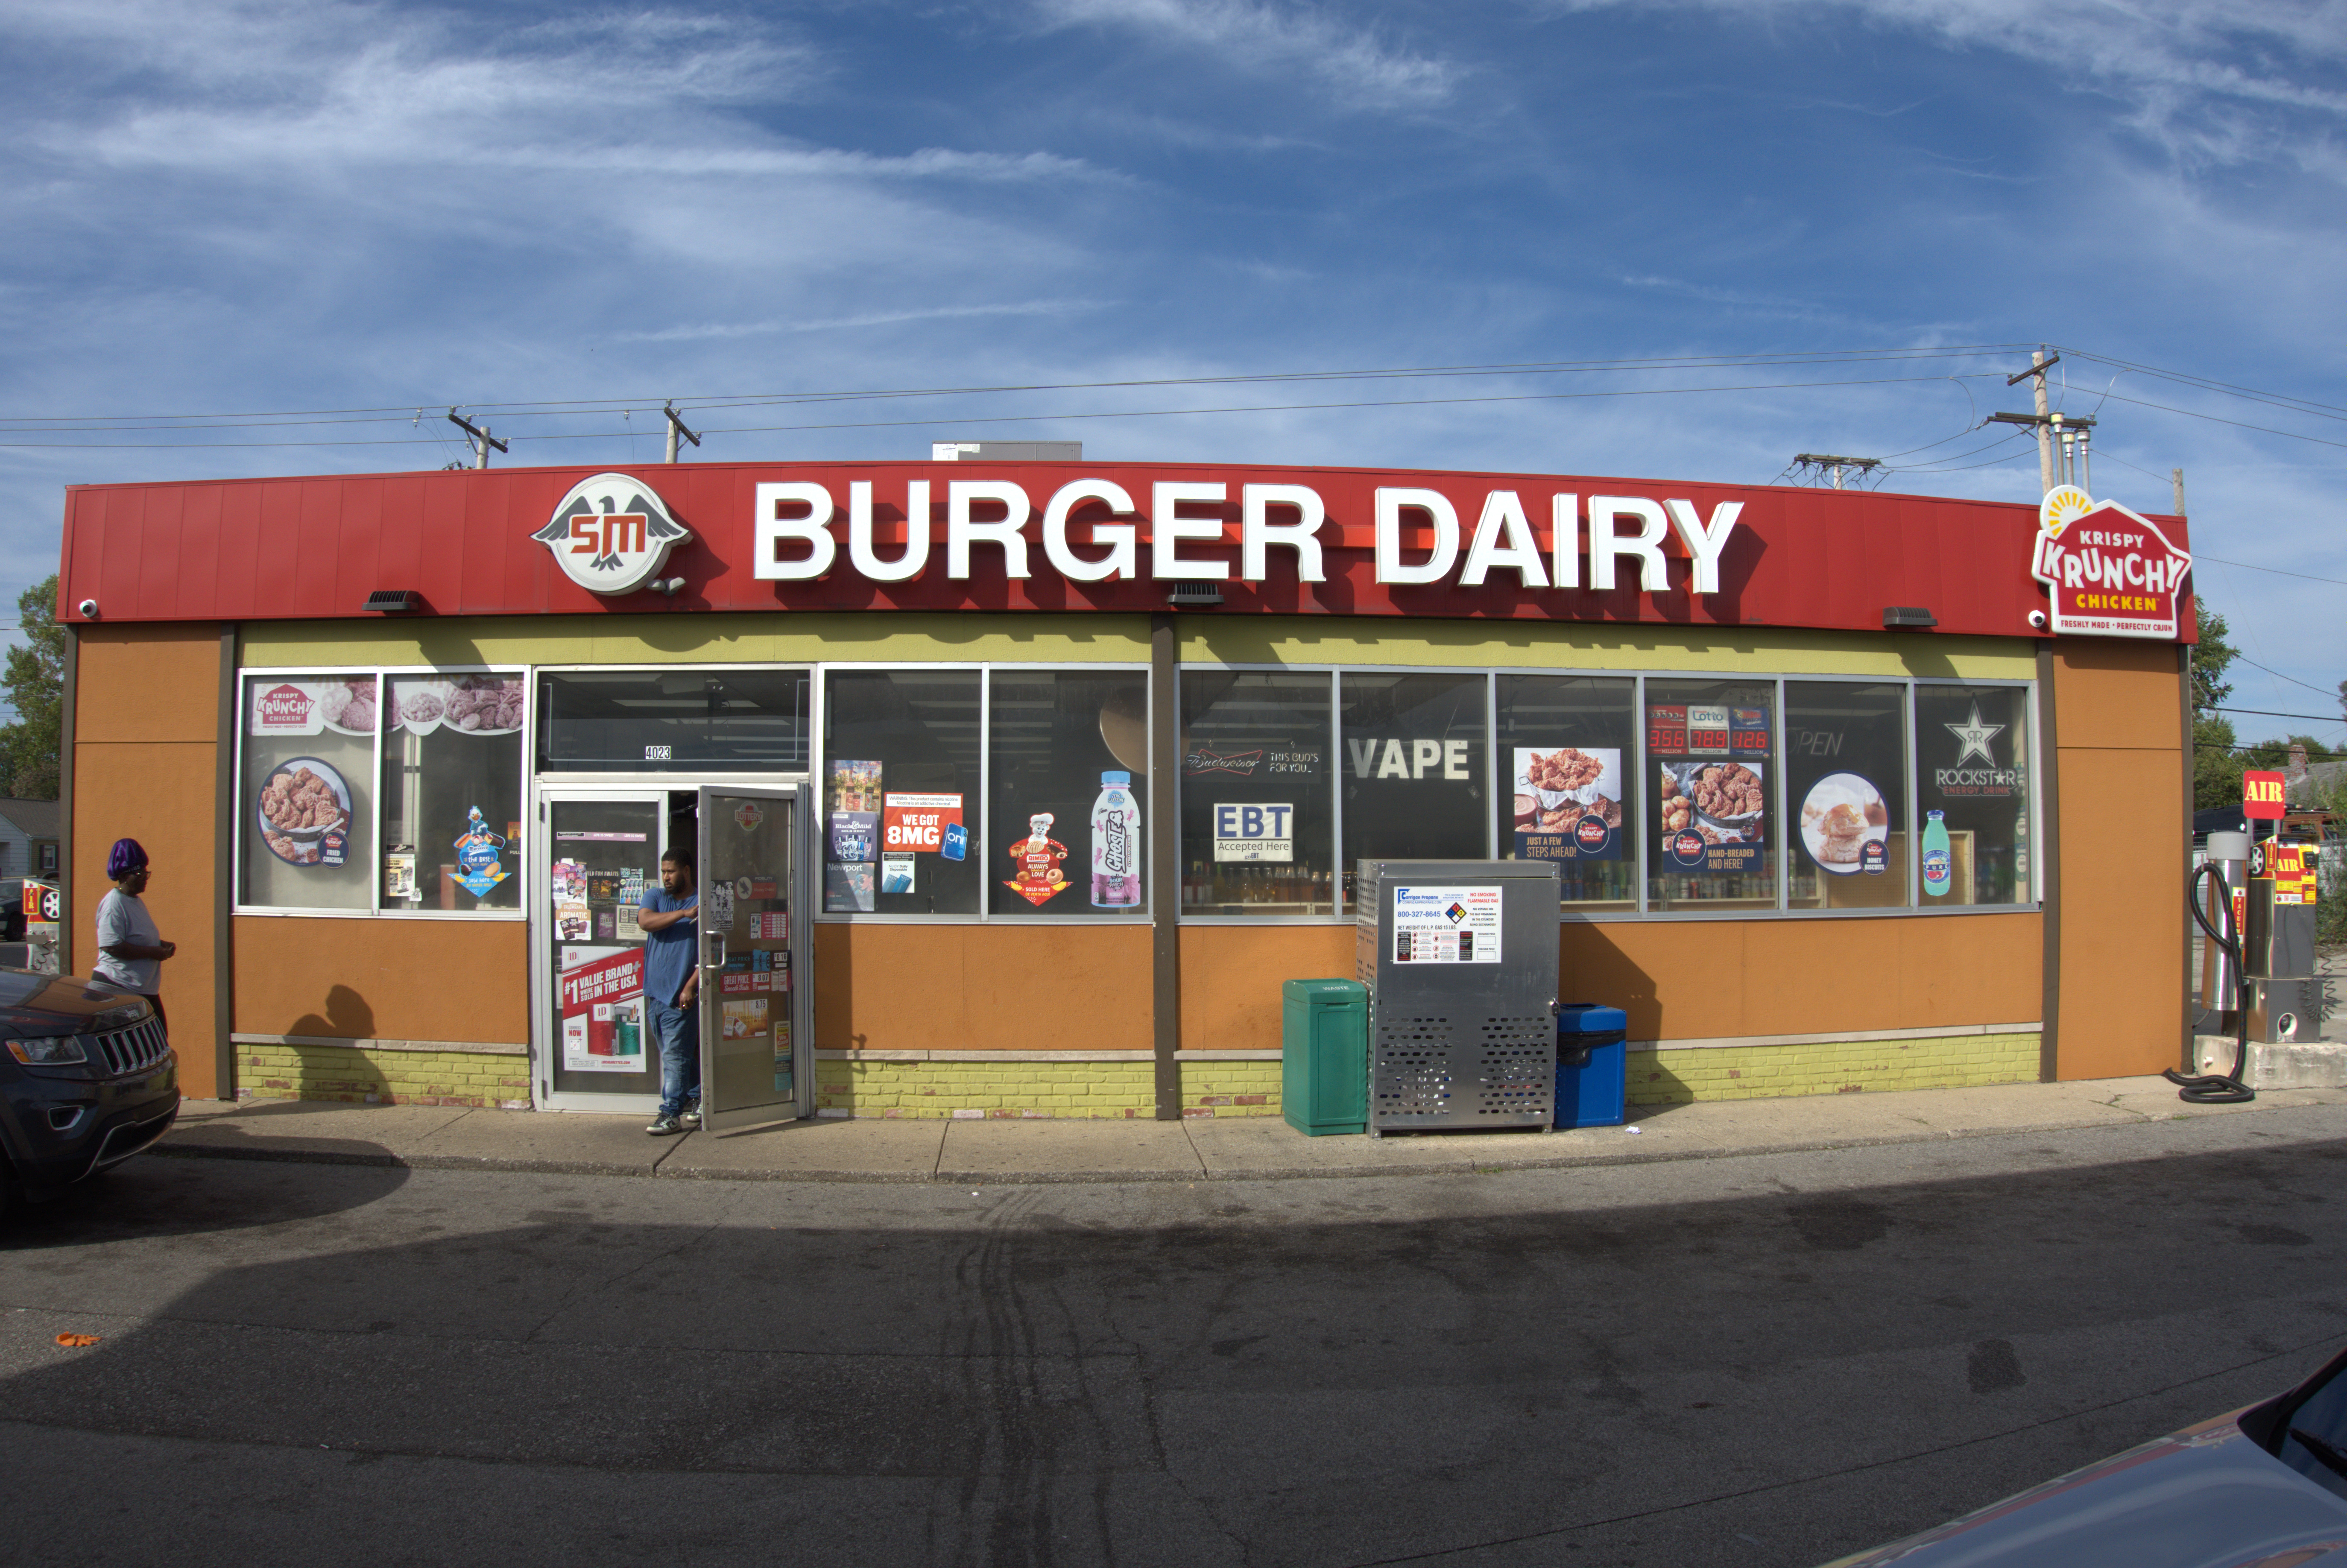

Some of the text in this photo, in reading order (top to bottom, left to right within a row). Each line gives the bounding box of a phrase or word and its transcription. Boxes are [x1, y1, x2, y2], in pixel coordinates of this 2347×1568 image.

[754, 478, 1744, 594] BURGER DAIRY
[2080, 531, 2144, 548] KRISPY
[2043, 541, 2185, 593] KRUNCHY
[2076, 594, 2157, 611] CHICKEN
[2061, 620, 2089, 628] FRESHLY
[2116, 623, 2151, 631] PERFECTLY
[258, 698, 313, 714] KRUNCHY
[1693, 711, 1723, 721] Lotto
[646, 746, 670, 759] 4023
[1270, 753, 1318, 762] THIS BUD'S
[1185, 755, 1259, 768] Budweiser
[1348, 738, 1469, 779] VAPE
[1270, 763, 1287, 772] FOR
[2245, 781, 2283, 802] AIR
[737, 812, 762, 820] LOTTERY
[902, 814, 939, 825] WE GOT
[1218, 807, 1291, 837] EBT
[887, 826, 939, 845] 8MG
[1527, 837, 1561, 845] JUST A FEW
[1105, 819, 1127, 874] GHOST
[1218, 842, 1289, 852] Accepted Here
[1527, 847, 1576, 857] STEPS AHEAD!
[1708, 849, 1754, 857] HAND-BREADED
[827, 863, 863, 872] Newport
[1708, 859, 1743, 869] AND HERE!
[2277, 859, 2300, 872] AIR
[1401, 892, 1420, 900] Corrigan
[569, 952, 577, 960] LD
[579, 971, 604, 989] VALUE
[724, 975, 737, 985] GREAT
[565, 979, 578, 1004] #1
[580, 987, 593, 996] WHERE
[594, 974, 638, 998] IN THE USA
[581, 993, 594, 1002] SOLD
[756, 1000, 766, 1008] 8.75
[598, 1006, 606, 1016] LD
